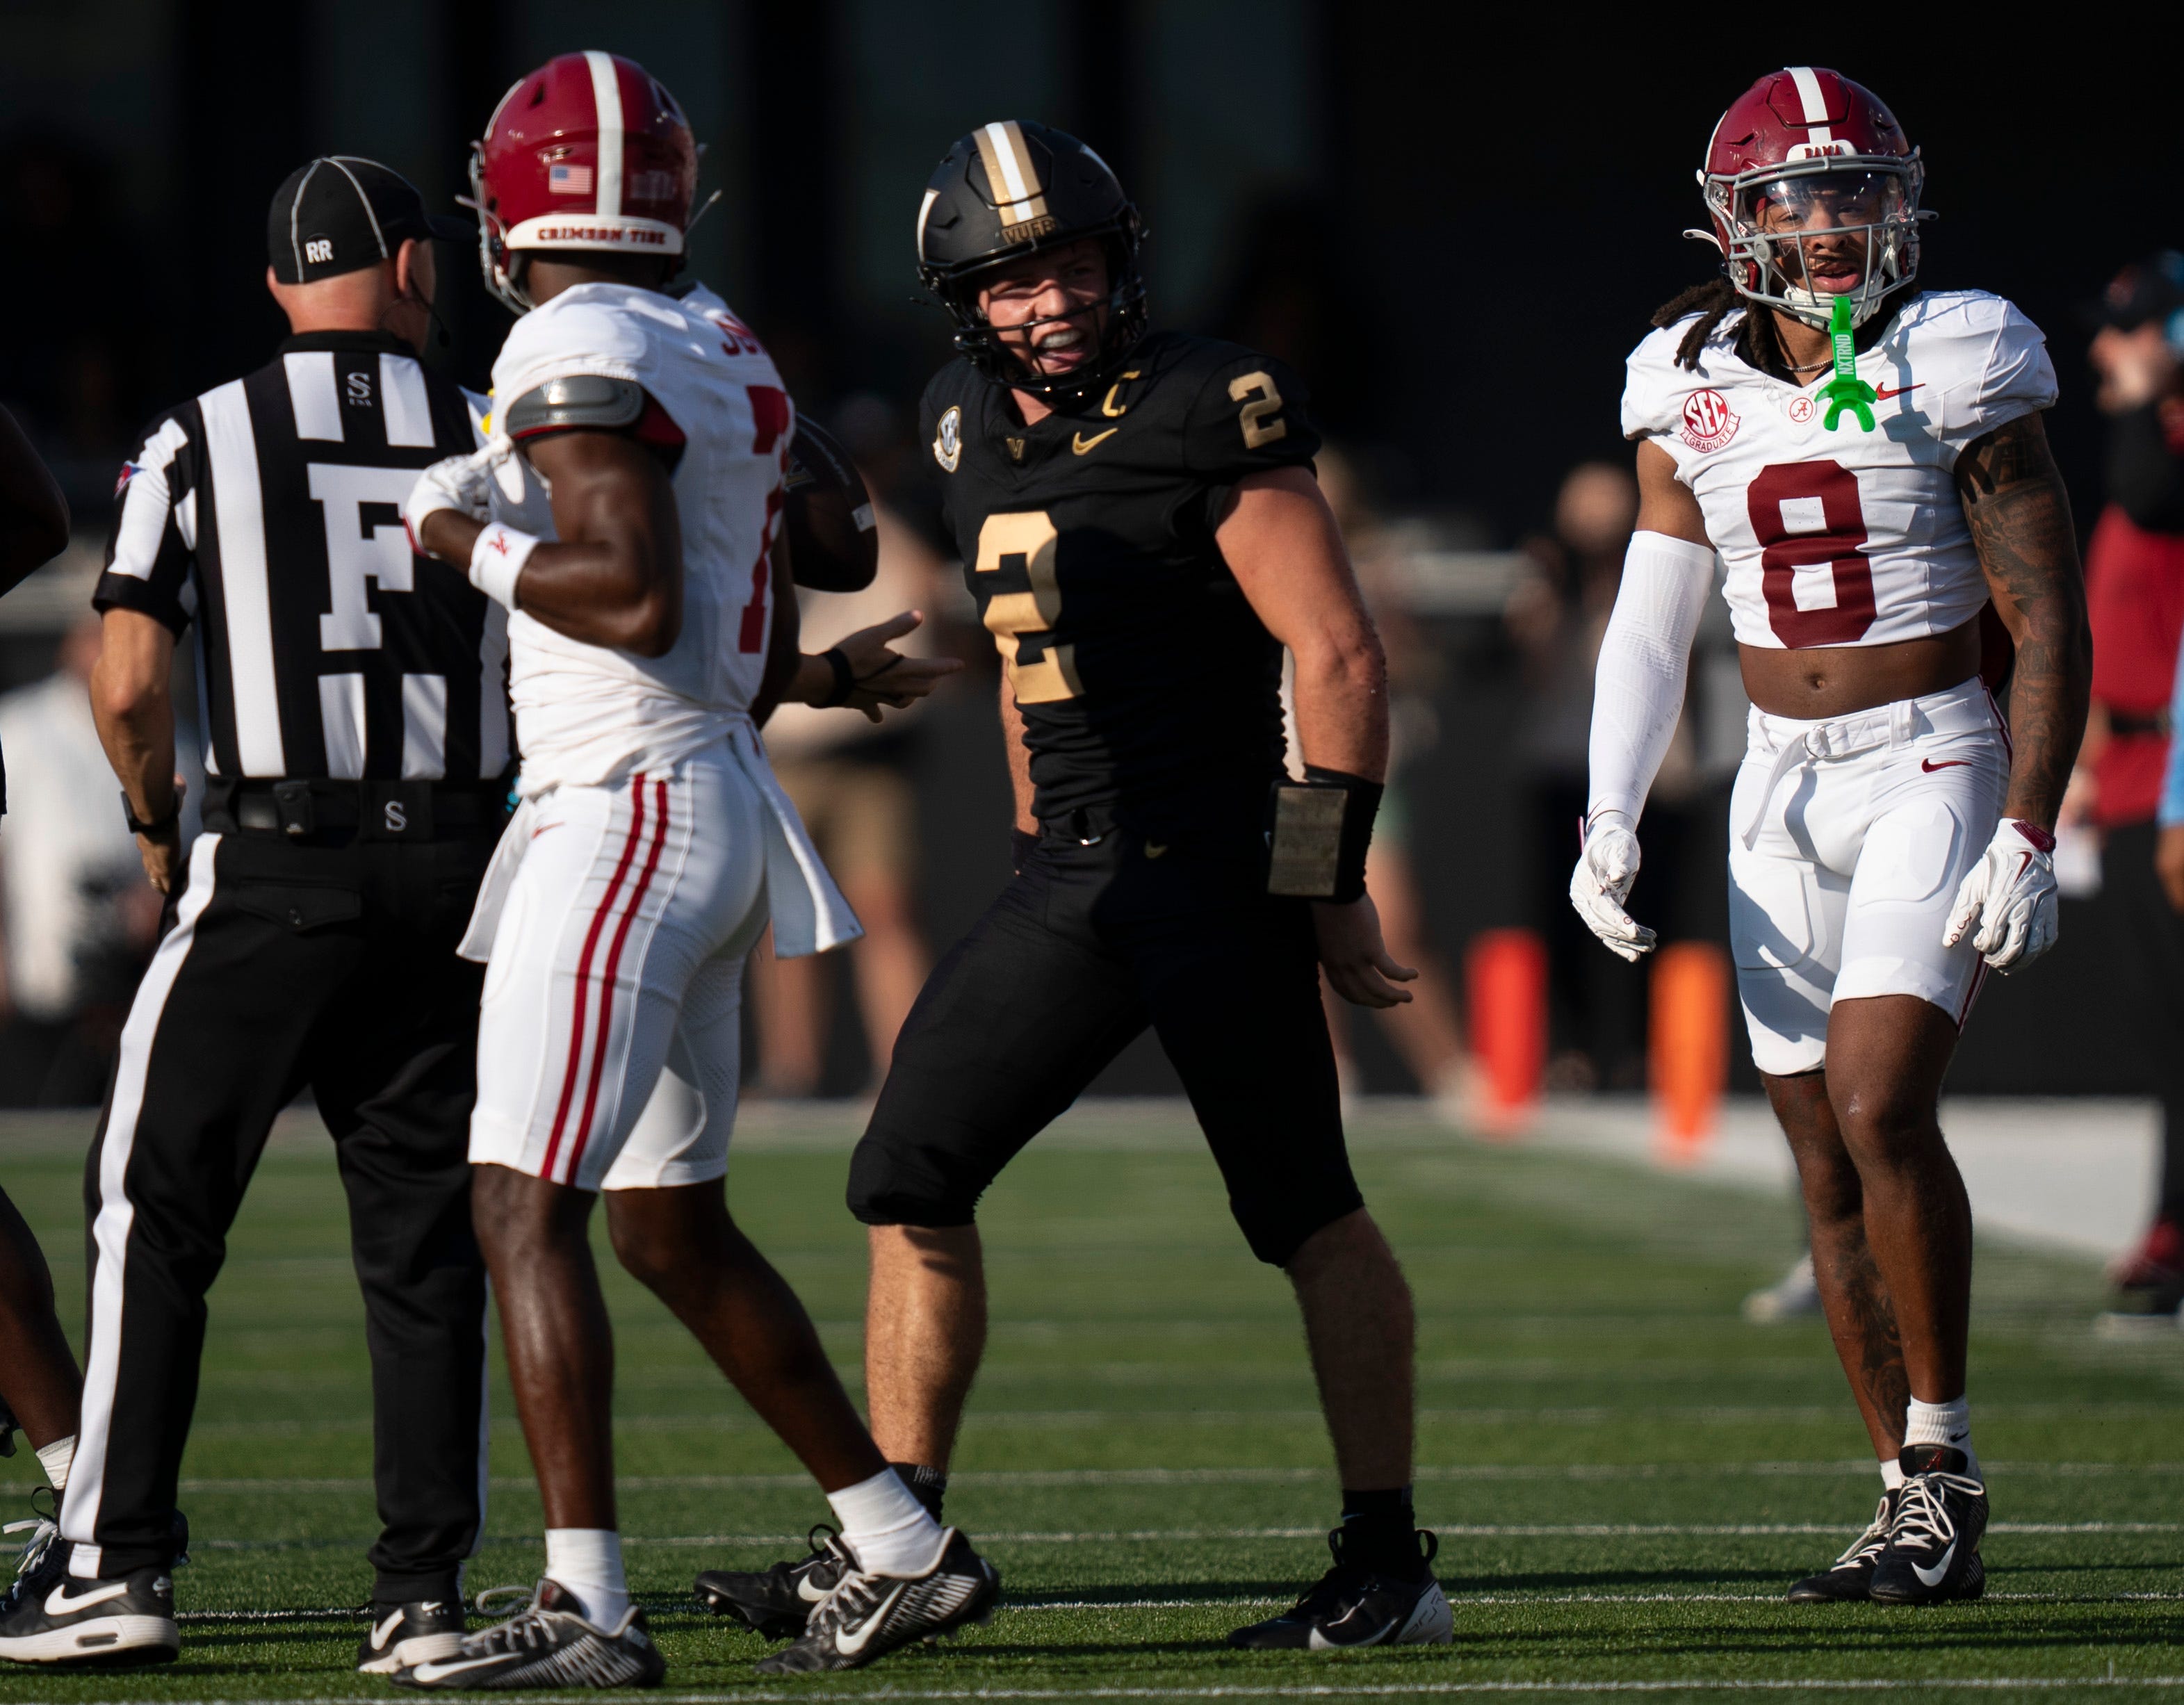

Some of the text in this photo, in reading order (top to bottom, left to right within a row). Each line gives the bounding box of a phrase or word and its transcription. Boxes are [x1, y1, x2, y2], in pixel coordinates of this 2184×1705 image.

[1804, 145, 1842, 159] BAMA
[306, 239, 334, 263] RR
[538, 227, 666, 244] CRIMSON TIDE
[1835, 334, 1854, 375] NXTRND
[1228, 370, 1286, 449] 2
[1686, 391, 1726, 436] SEC
[1689, 427, 1734, 451] GRADUATE
[307, 462, 425, 652] F
[1747, 459, 1877, 649] 8
[975, 511, 1086, 705] 2
